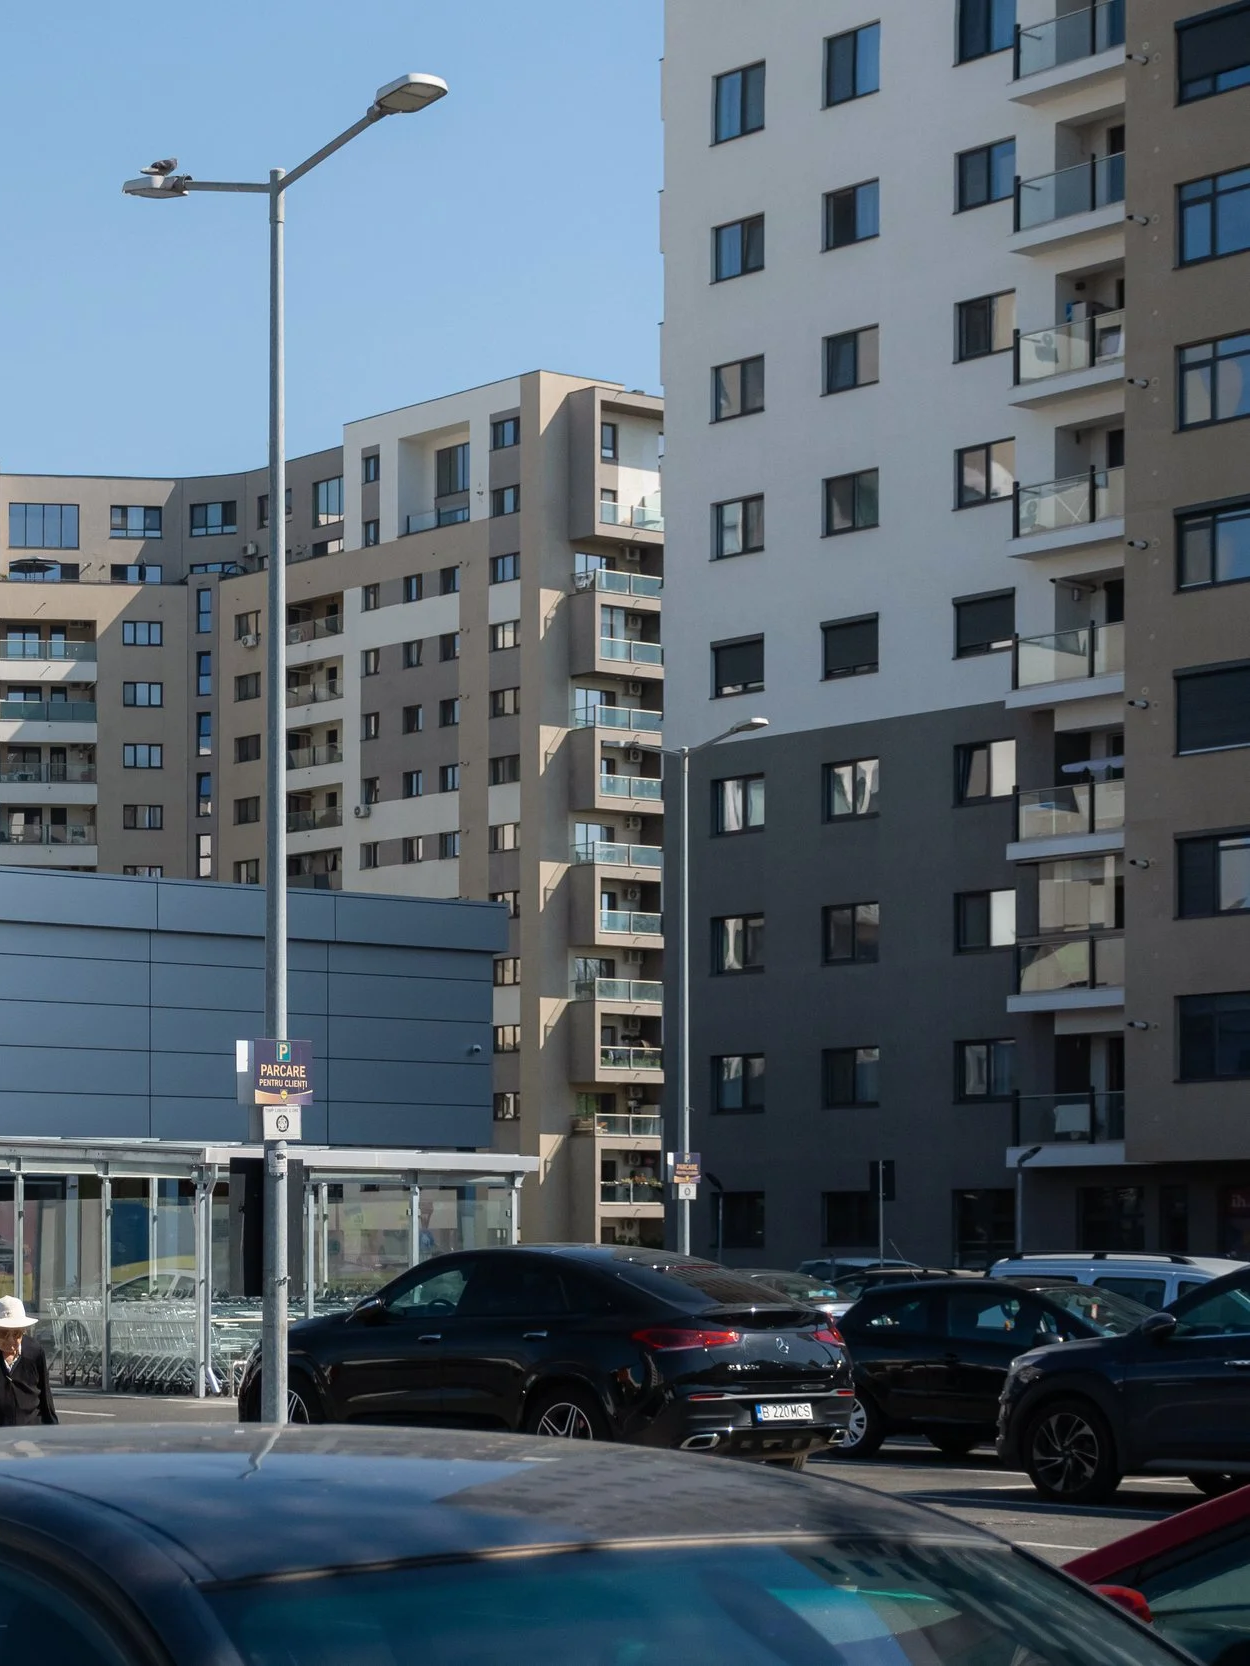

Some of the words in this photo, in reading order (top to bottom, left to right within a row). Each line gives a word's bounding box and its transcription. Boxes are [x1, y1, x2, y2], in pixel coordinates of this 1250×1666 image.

[279, 1044, 288, 1060] P
[260, 1064, 306, 1077] PARCARE
[259, 1079, 284, 1087] PENTRU
[284, 1080, 308, 1090] CLIENȚI
[762, 1406, 770, 1419] B
[773, 1406, 790, 1418] 220
[790, 1405, 811, 1418] MCS
